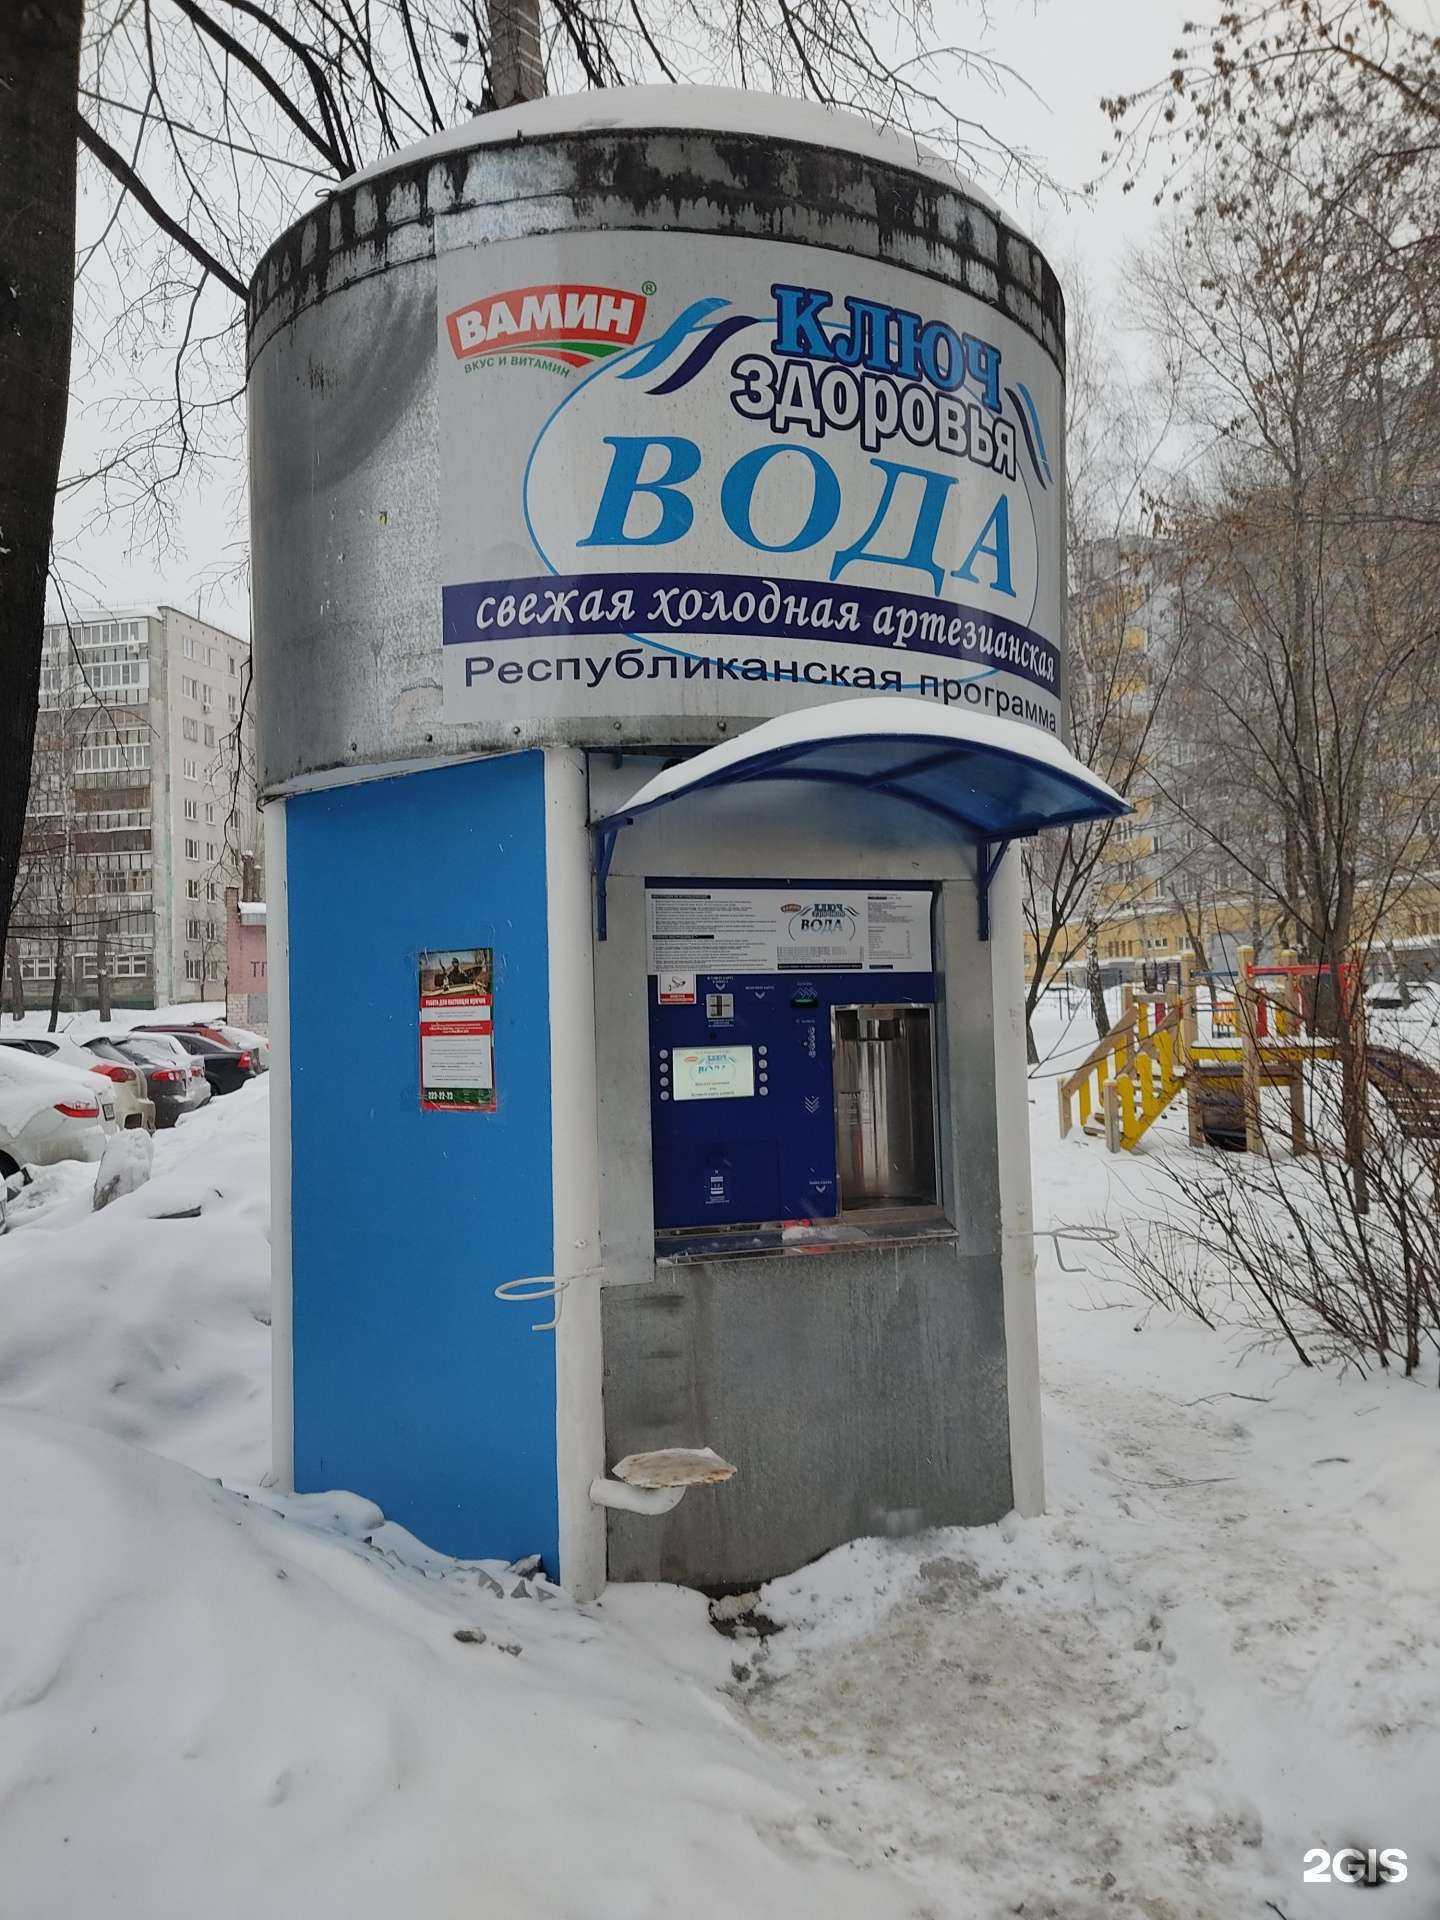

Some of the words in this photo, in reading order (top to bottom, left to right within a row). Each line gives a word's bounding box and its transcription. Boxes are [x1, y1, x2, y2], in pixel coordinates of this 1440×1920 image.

[456, 293, 635, 350] ВАМИН
[464, 357, 495, 374] ВКУС
[499, 356, 508, 366] И
[510, 356, 570, 378] ВИТАМИН
[771, 283, 1001, 413] КЛЮЧ
[576, 436, 1016, 598] ВОДА
[476, 588, 635, 629] свежая
[647, 580, 861, 632] холодная
[872, 604, 1055, 683] артезианская
[465, 648, 902, 692] Республиканская
[920, 674, 1057, 733] программа
